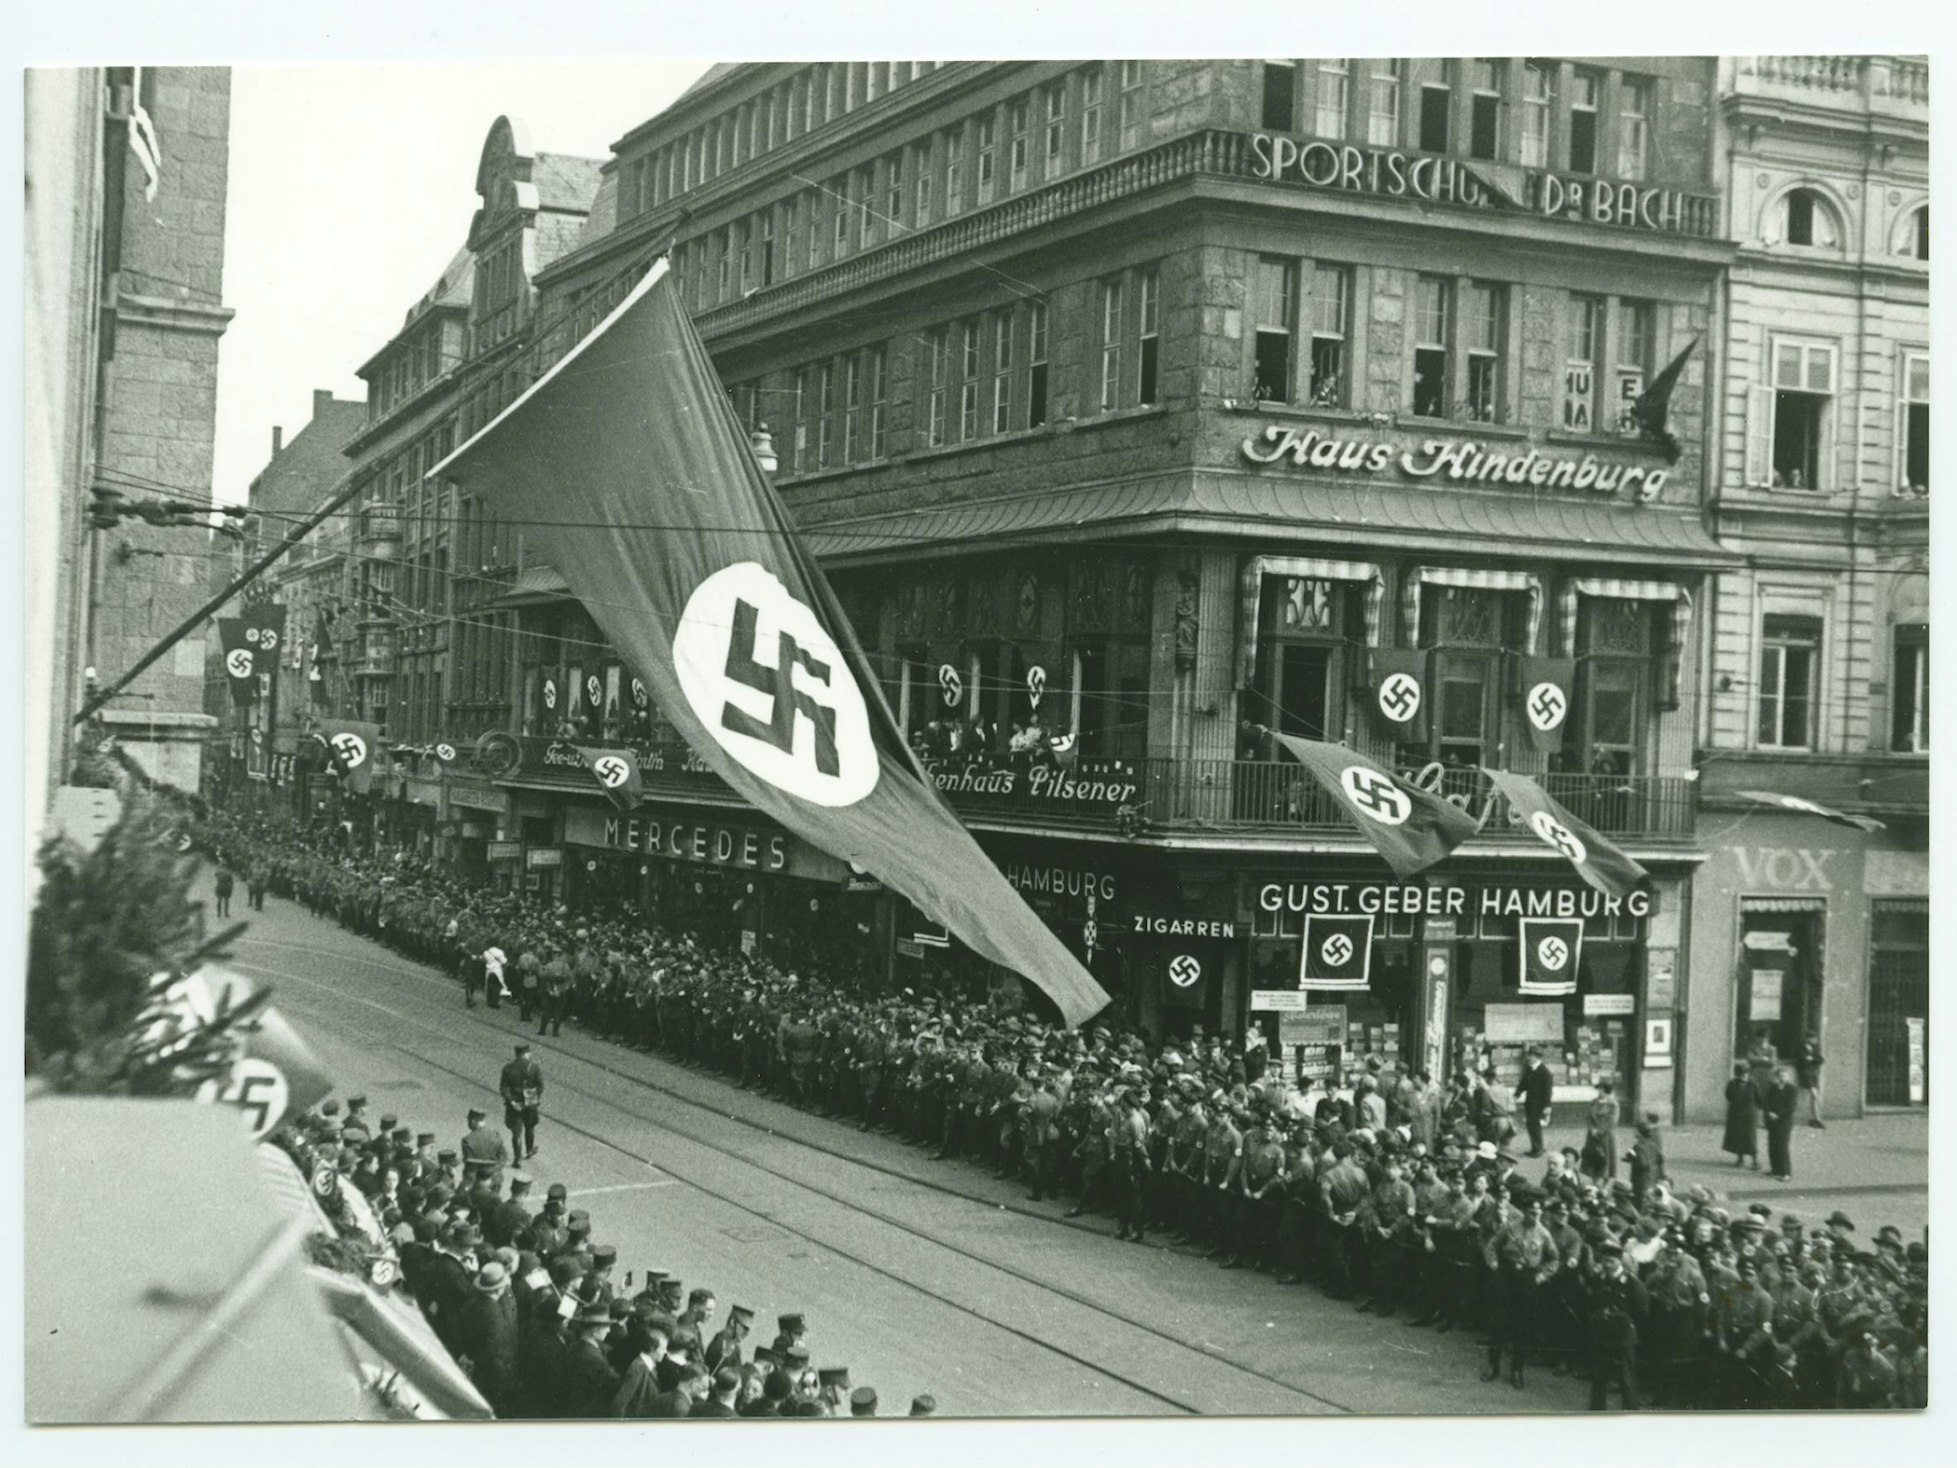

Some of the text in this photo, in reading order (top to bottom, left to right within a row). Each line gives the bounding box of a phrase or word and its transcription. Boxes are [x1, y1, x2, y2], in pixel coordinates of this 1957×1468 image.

[1252, 133, 1479, 205] SPORTSCHU
[1595, 180, 1683, 231] BACH
[1243, 425, 1669, 501] Haus Hindenburg
[1029, 764, 1136, 802] Pilsener
[604, 817, 785, 869] MERCEDES
[1007, 863, 1115, 900] HAMBURG
[1730, 846, 1836, 890] VOX
[1260, 884, 1649, 917] GUST. GEBER HAMBURG
[1134, 916, 1234, 938] ZIGARREN
